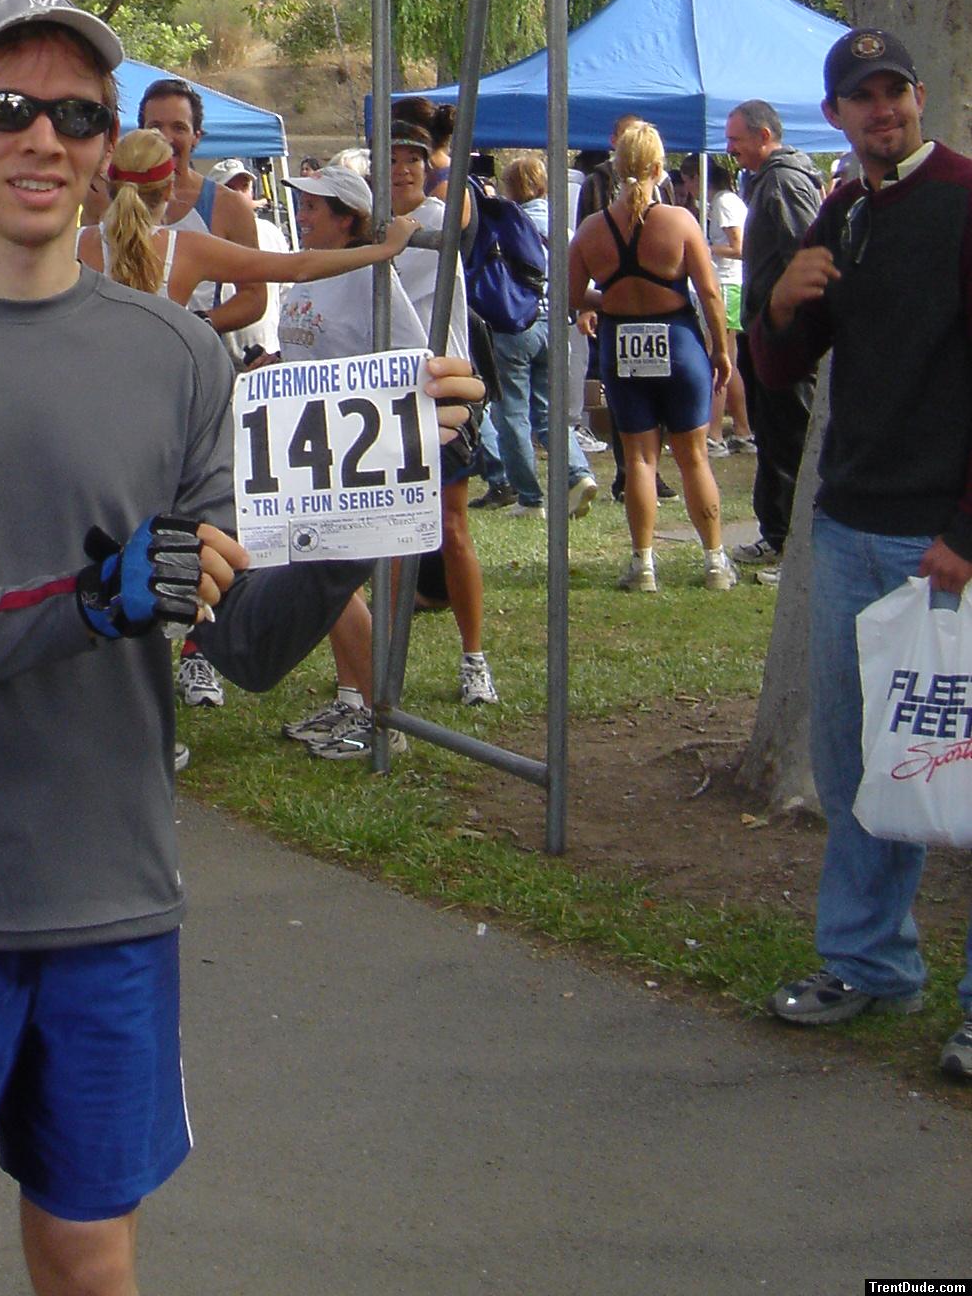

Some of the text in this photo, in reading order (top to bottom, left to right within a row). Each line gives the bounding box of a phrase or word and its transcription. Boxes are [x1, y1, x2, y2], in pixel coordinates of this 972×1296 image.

[619, 334, 668, 359] 1046
[247, 354, 421, 402] LIVERMORE CYCLERY
[241, 391, 430, 495] 1421
[253, 486, 425, 517] TRI 4 FUN SERIES '05
[887, 670, 972, 707] FLEE
